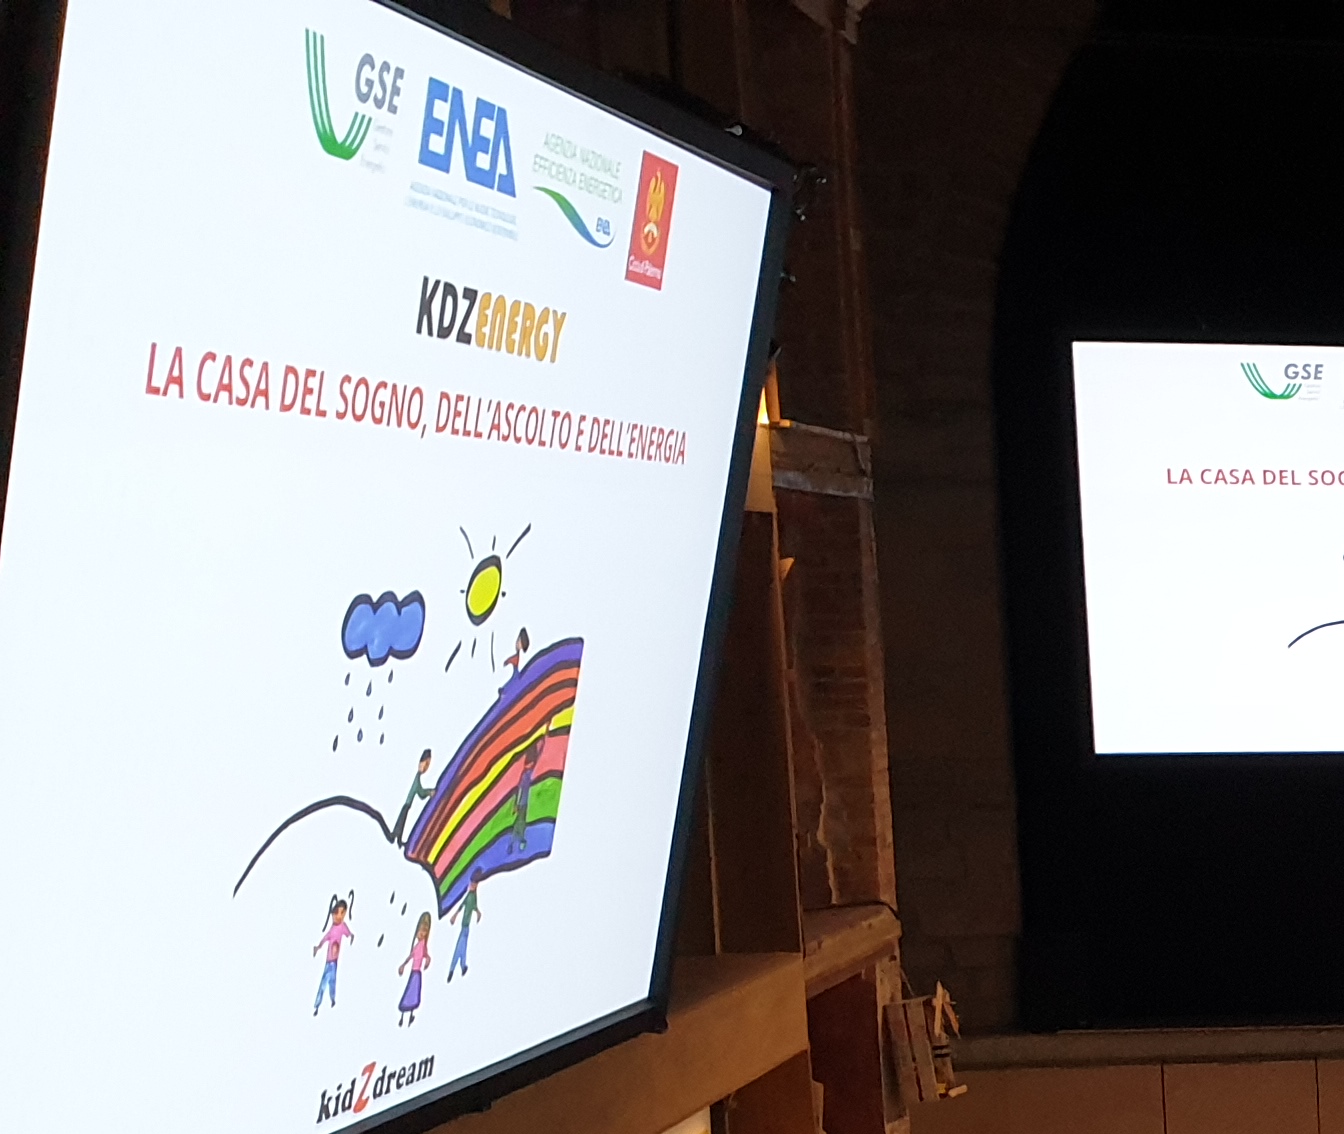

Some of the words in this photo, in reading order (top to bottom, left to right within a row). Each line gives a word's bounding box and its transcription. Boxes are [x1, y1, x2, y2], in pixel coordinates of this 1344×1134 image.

[355, 53, 405, 115] GSE
[418, 76, 517, 198] ENEA
[145, 341, 184, 399] LA
[196, 350, 270, 411] CASA
[279, 364, 326, 418] DEL
[335, 373, 426, 439] SOGNO,
[434, 391, 570, 450] DELL'ASCOLTO
[574, 413, 586, 453] E
[588, 416, 686, 465] DELL'ENERGIA
[1284, 362, 1324, 380] GSE
[1166, 467, 1193, 485] LA
[1200, 468, 1255, 487] CASA
[1262, 468, 1302, 488] DEL
[316, 1055, 435, 1124] kidZdream
